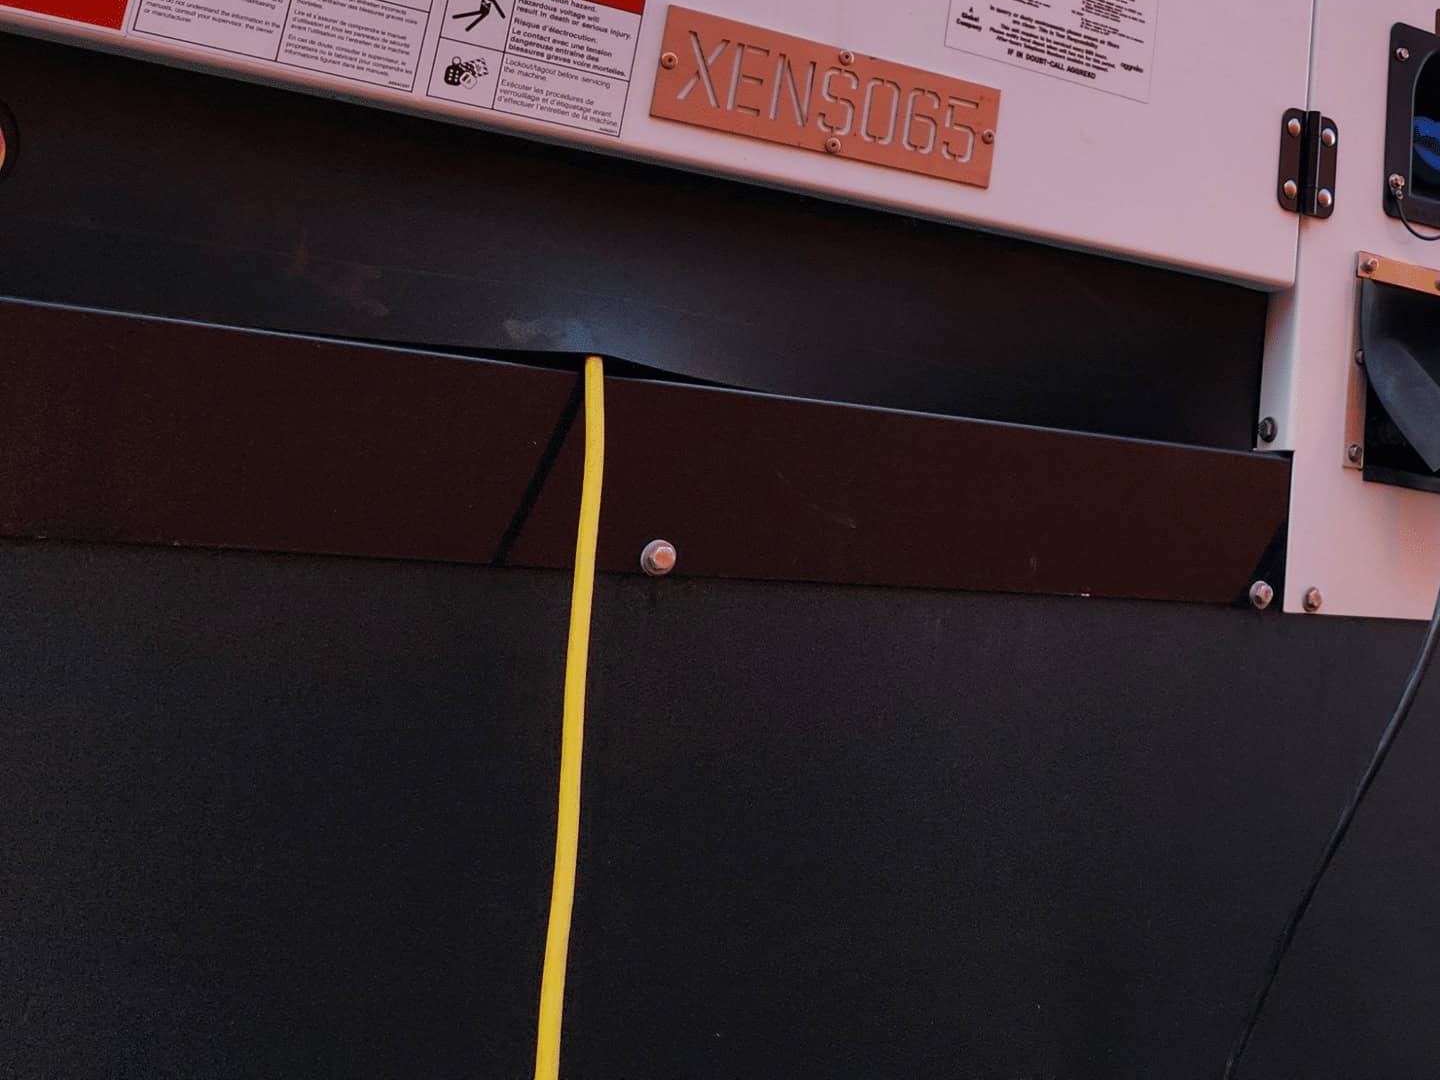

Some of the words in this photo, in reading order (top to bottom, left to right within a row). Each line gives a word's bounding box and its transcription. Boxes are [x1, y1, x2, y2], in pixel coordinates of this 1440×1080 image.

[513, 17, 540, 29] Risque
[516, 6, 538, 16] result
[540, 10, 547, 18] in
[549, 14, 569, 23] death
[581, 22, 608, 33] serious
[559, 8, 586, 19] voltage
[510, 36, 553, 51] dangereuse
[585, 54, 599, 62] des
[511, 27, 522, 35] Le
[522, 31, 550, 42] contact
[551, 38, 569, 47] avec
[586, 46, 612, 57] tension
[508, 43, 544, 57] blessures
[546, 53, 571, 64] graves
[572, 59, 591, 68] voire
[557, 70, 578, 80] before
[581, 76, 610, 89] servicing
[533, 86, 543, 94] les
[592, 109, 612, 117] avant
